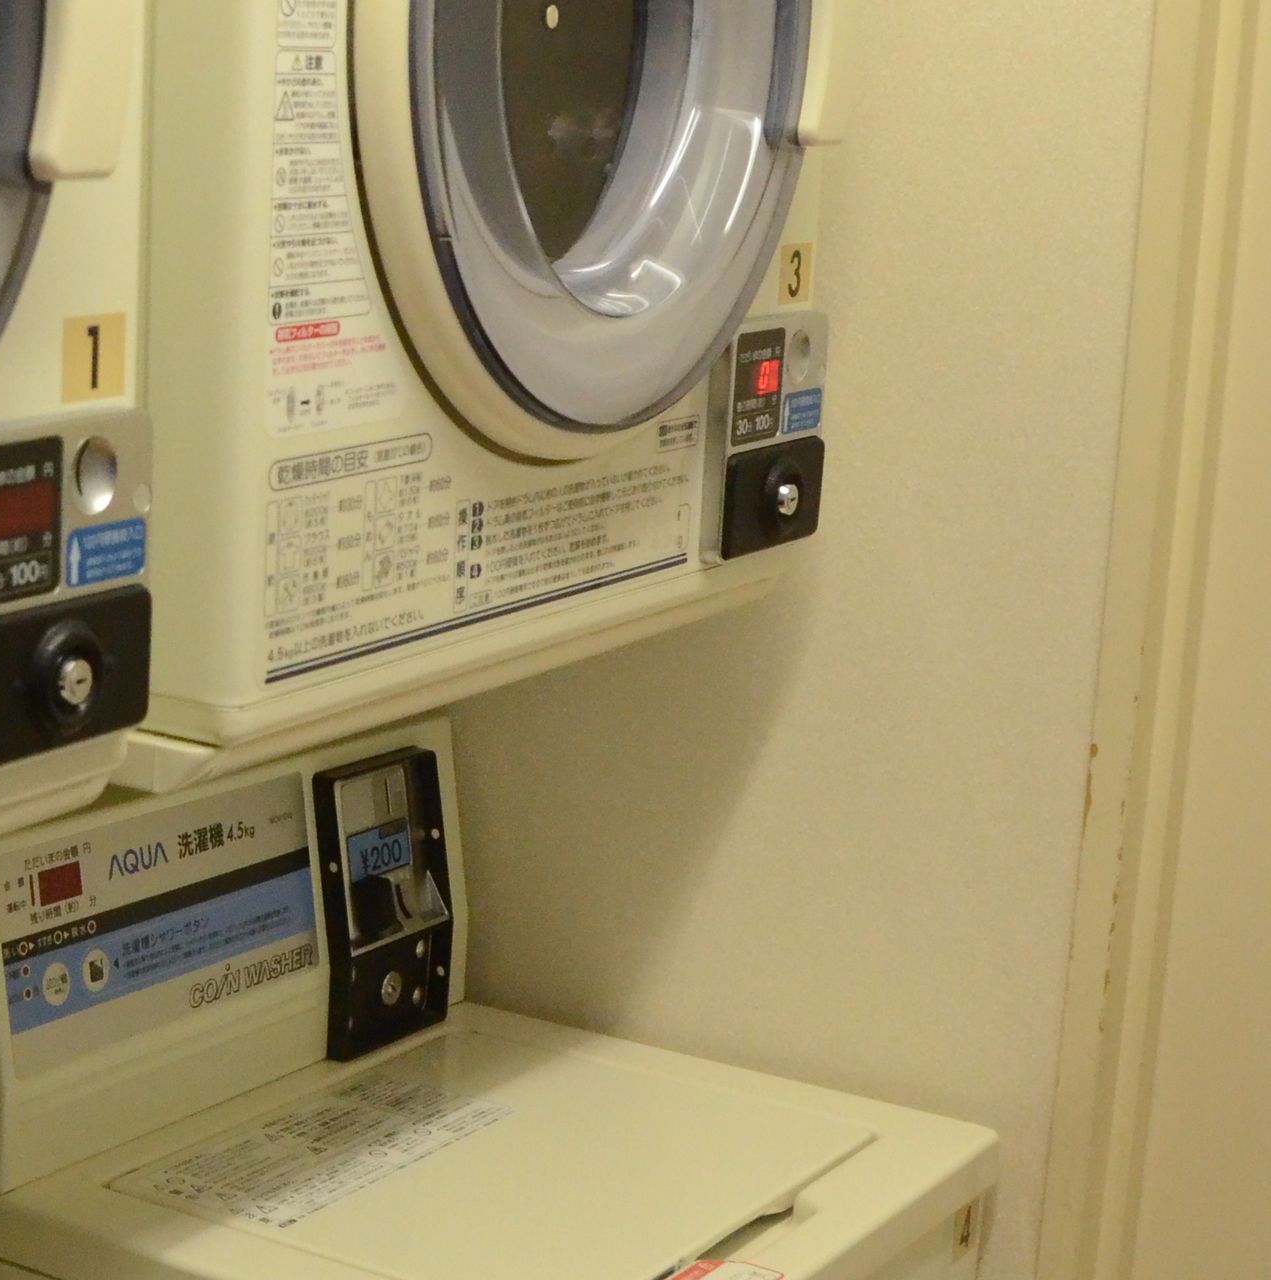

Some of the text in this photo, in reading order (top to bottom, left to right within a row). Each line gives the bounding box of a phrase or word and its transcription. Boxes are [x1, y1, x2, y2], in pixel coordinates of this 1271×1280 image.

[788, 249, 802, 298] 3
[87, 325, 101, 389] 1
[108, 841, 170, 881] AQUA
[177, 821, 257, 859] 洗濯機 4.5kg
[361, 838, 402, 874] ¥200
[244, 943, 314, 989] WASHER
